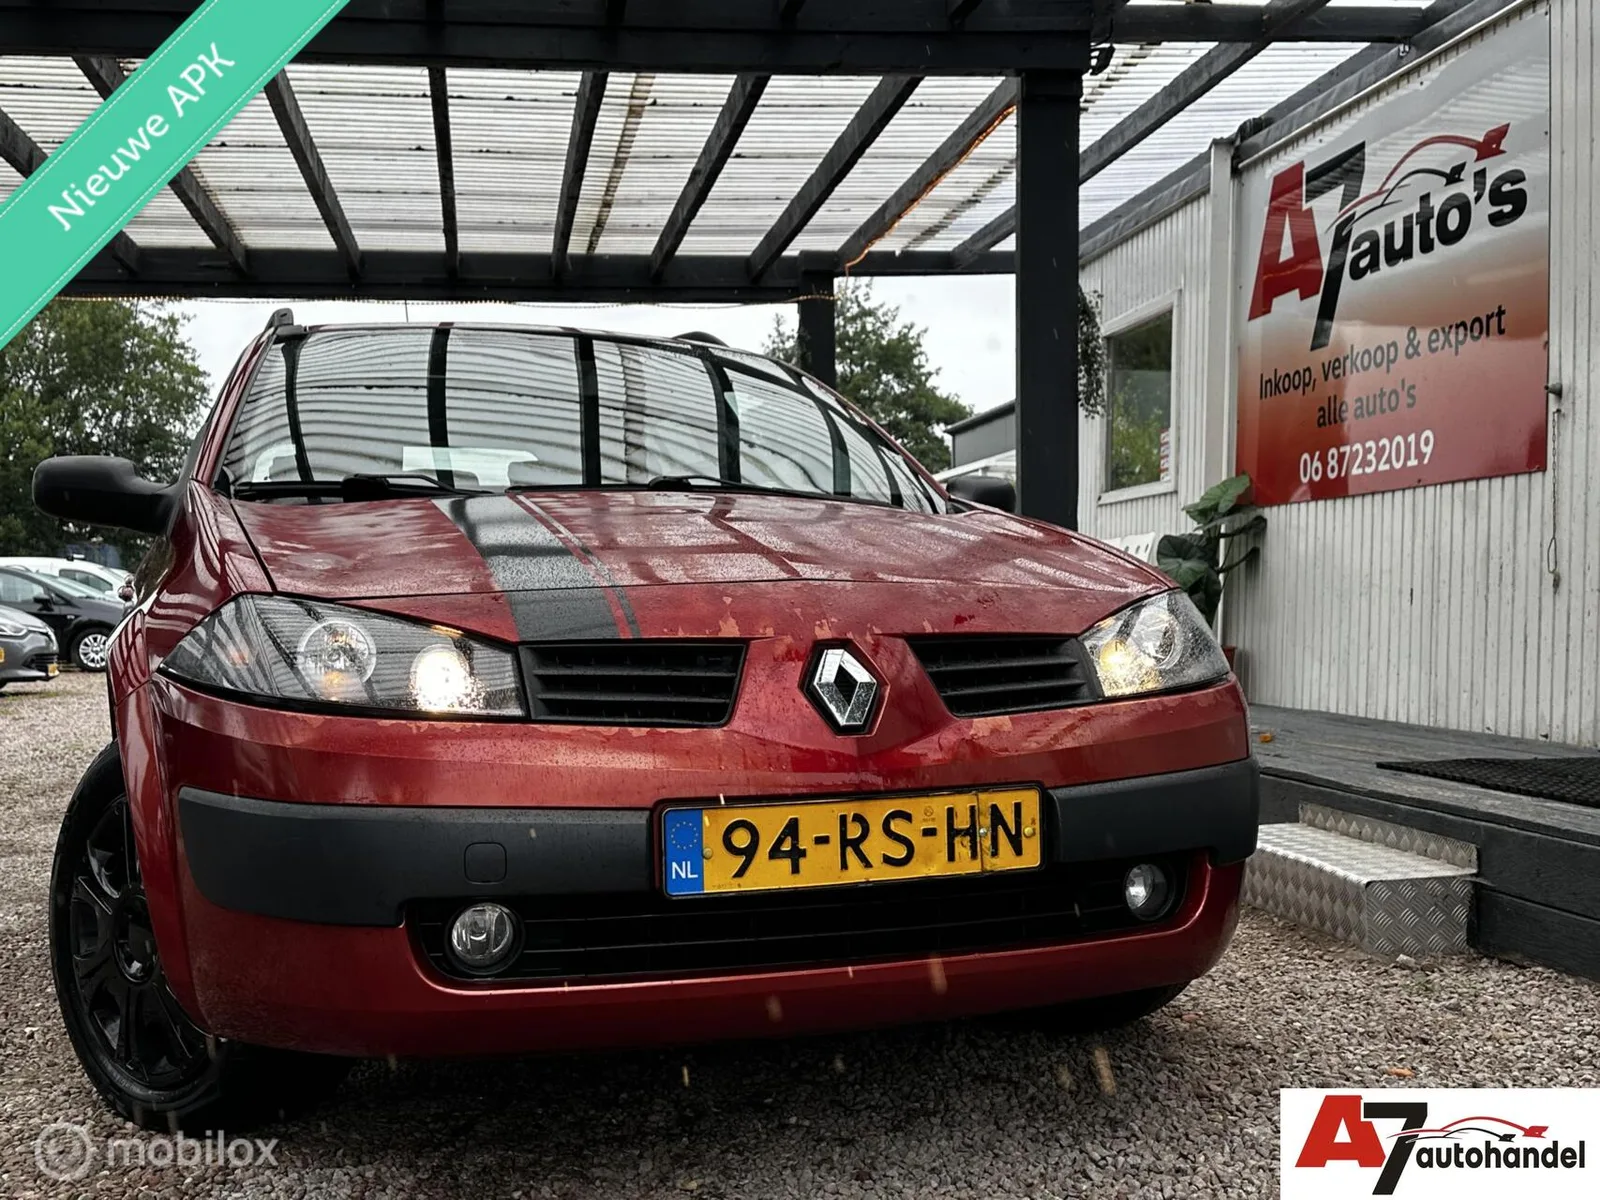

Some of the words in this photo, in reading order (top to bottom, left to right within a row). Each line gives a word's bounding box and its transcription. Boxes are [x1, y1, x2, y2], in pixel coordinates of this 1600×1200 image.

[1259, 367, 1318, 400] Inkoop,
[1321, 344, 1400, 382] verkoop
[1404, 326, 1422, 361] &
[1427, 305, 1507, 357] export
[1316, 393, 1349, 429] alle
[1353, 378, 1418, 420] auto's
[1300, 451, 1323, 484] 06
[1326, 430, 1436, 476] 87232019
[721, 800, 1025, 880] 94-RS-HN
[671, 860, 699, 881] NL
